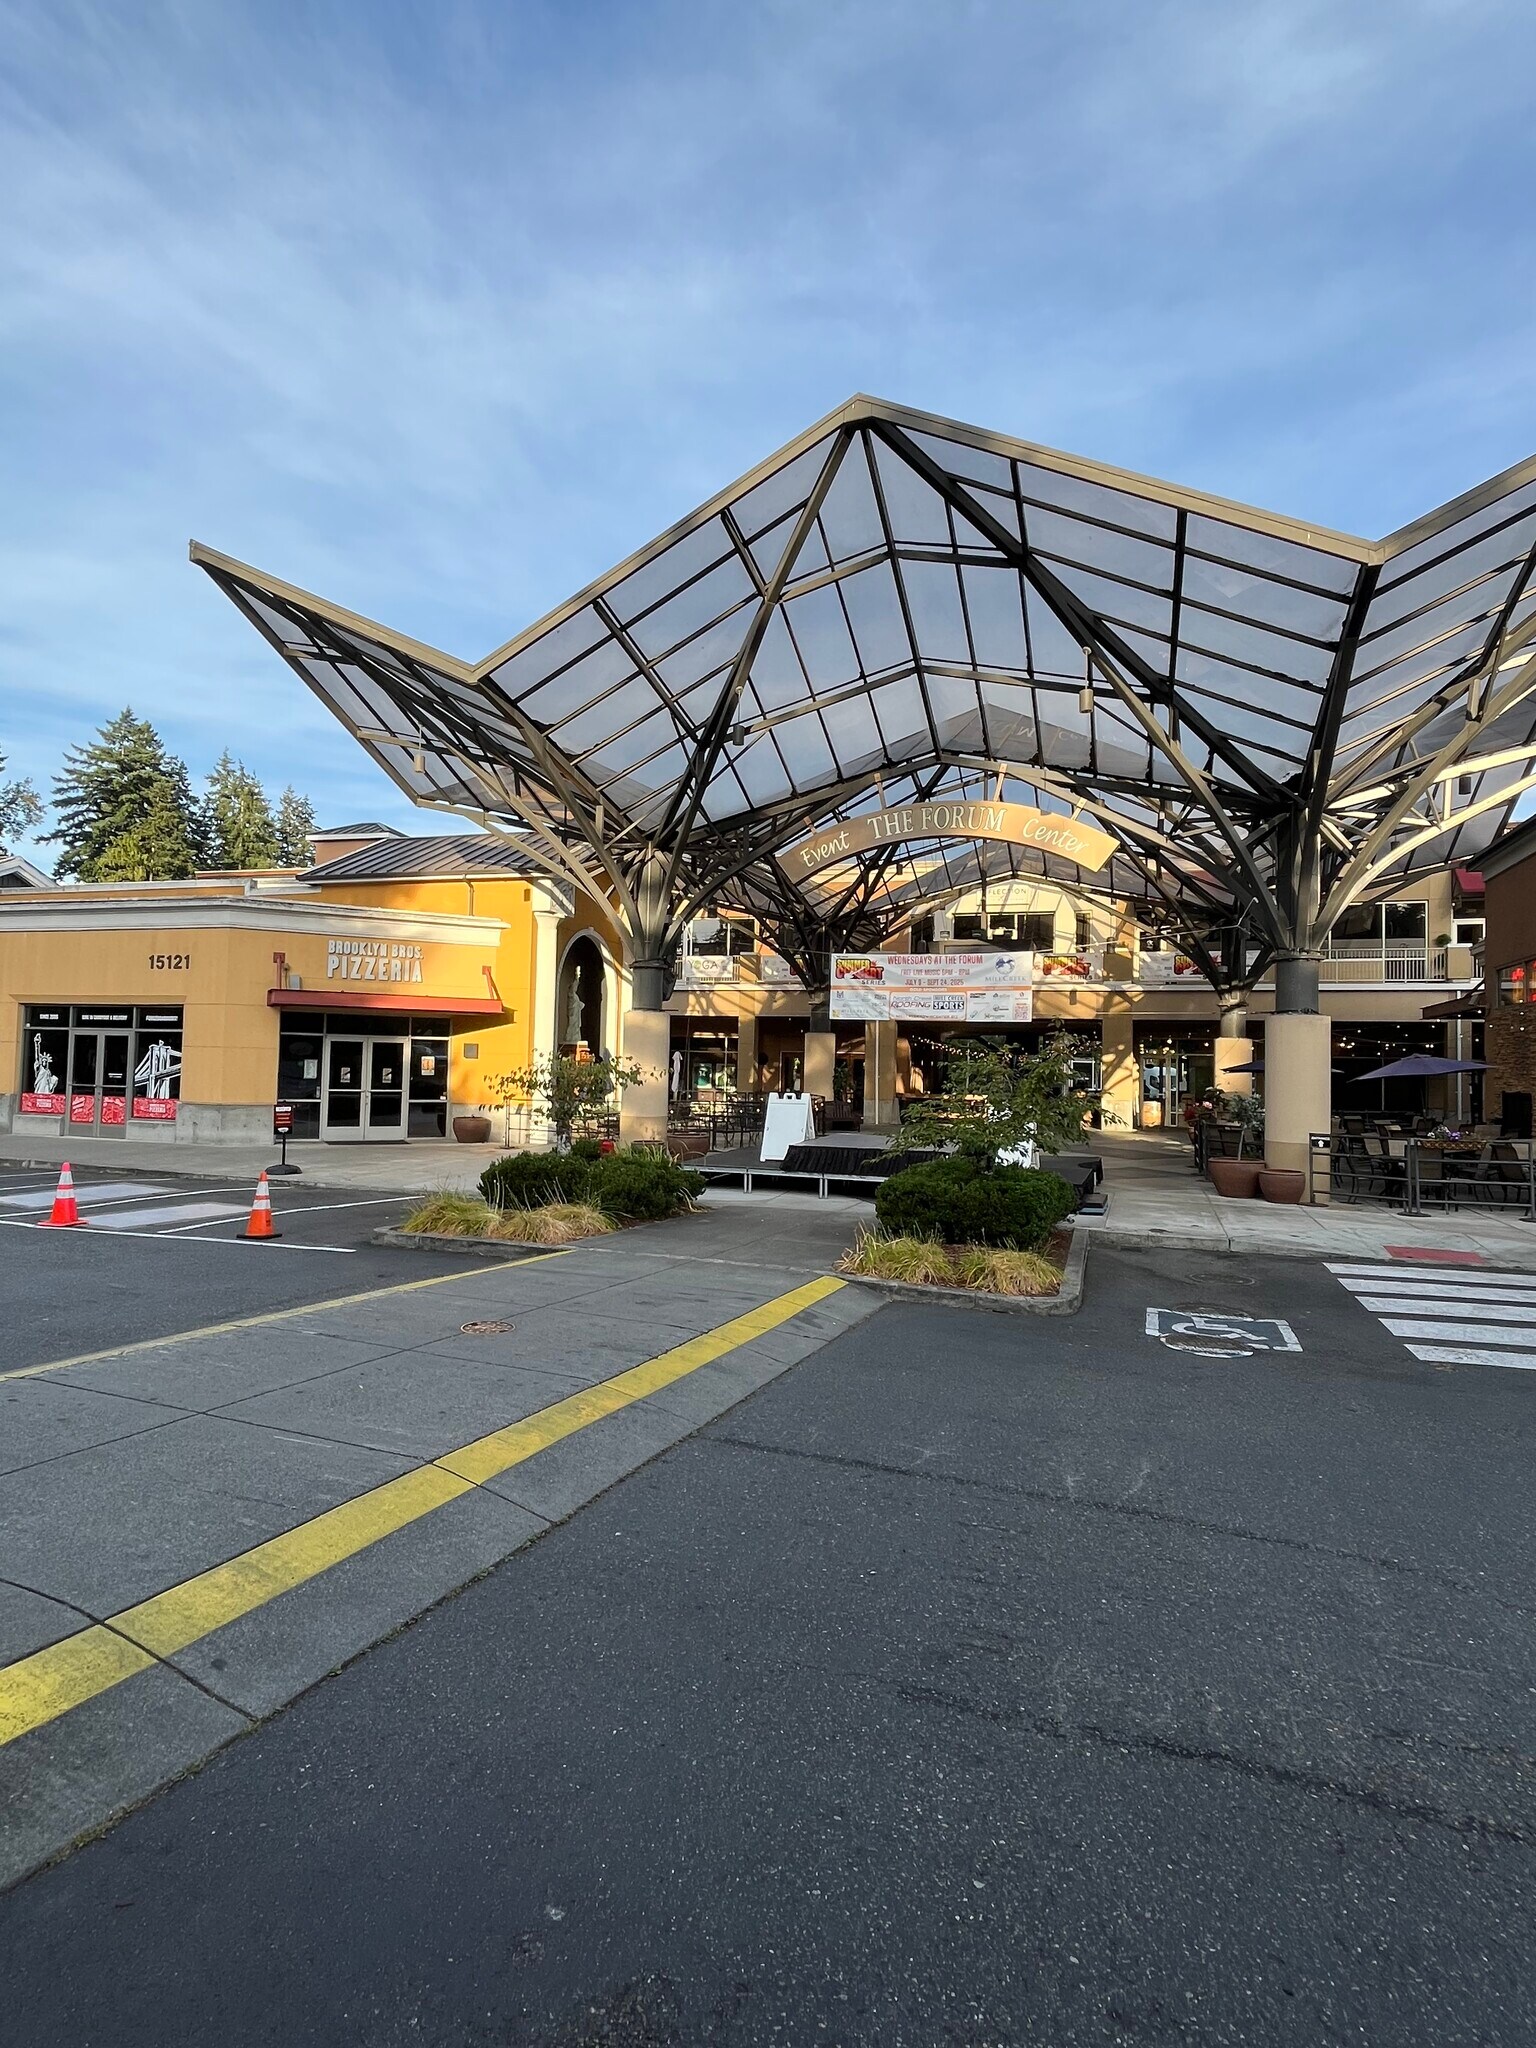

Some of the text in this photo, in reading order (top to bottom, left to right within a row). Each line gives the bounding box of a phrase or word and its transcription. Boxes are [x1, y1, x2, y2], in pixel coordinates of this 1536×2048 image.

[799, 804, 1090, 869] Event THE FORUM Center
[327, 942, 424, 960] BROOKLYN BROS.
[148, 954, 191, 970] 15121
[687, 959, 719, 970] YOGA
[887, 955, 983, 965] WEDNESDAYS AT THE FORUM
[327, 955, 424, 984] PIZZERIA
[927, 978, 939, 986] SEPT
[890, 1000, 932, 1009] ROOFING
[933, 1001, 964, 1009] SPORTS
